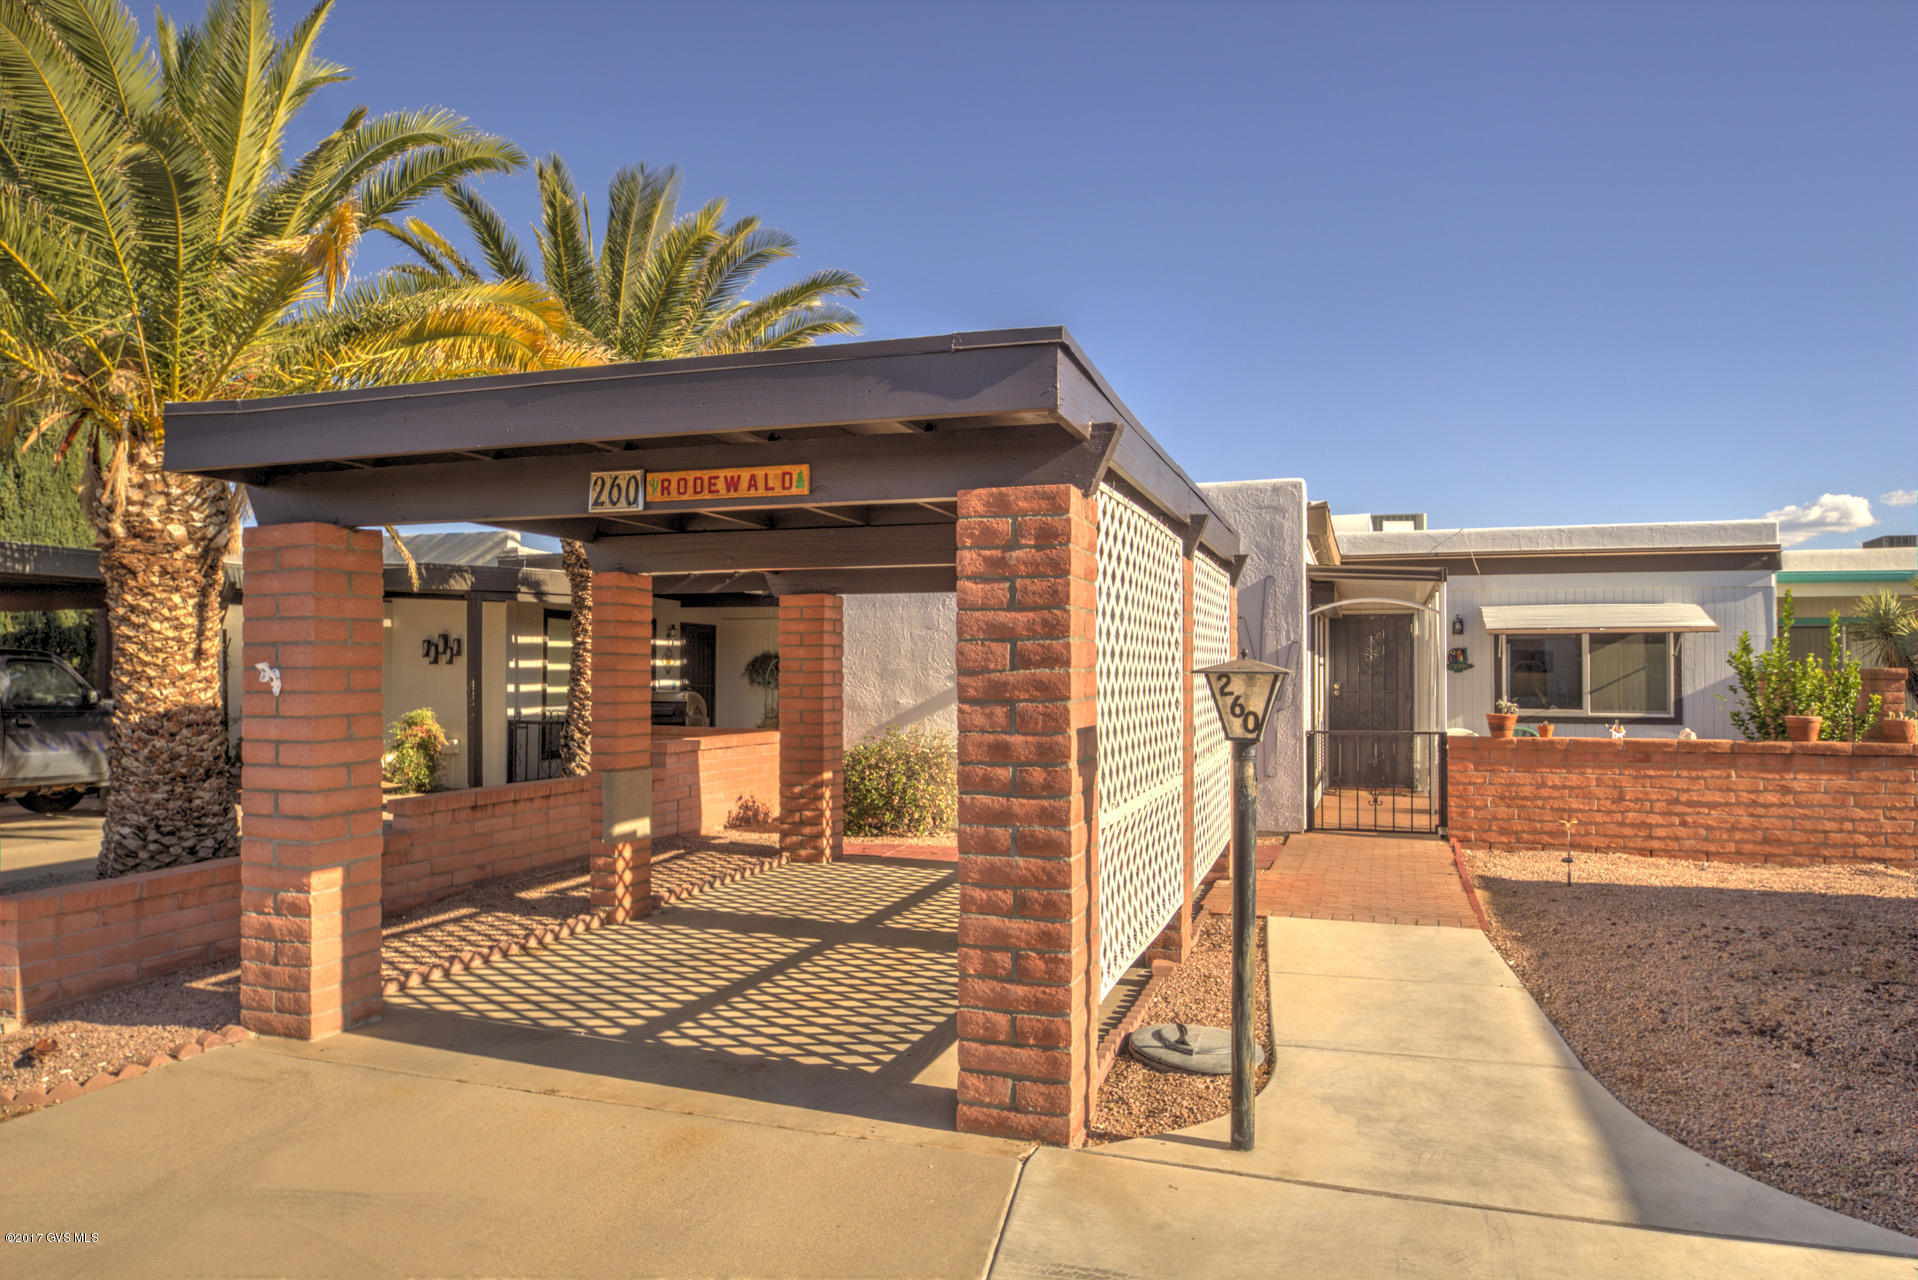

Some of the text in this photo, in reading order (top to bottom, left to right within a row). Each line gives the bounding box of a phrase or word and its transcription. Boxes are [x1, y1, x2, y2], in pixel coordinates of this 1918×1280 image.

[592, 475, 640, 507] 260
[660, 471, 793, 496] RODEWALD
[1216, 674, 1260, 734] 260
